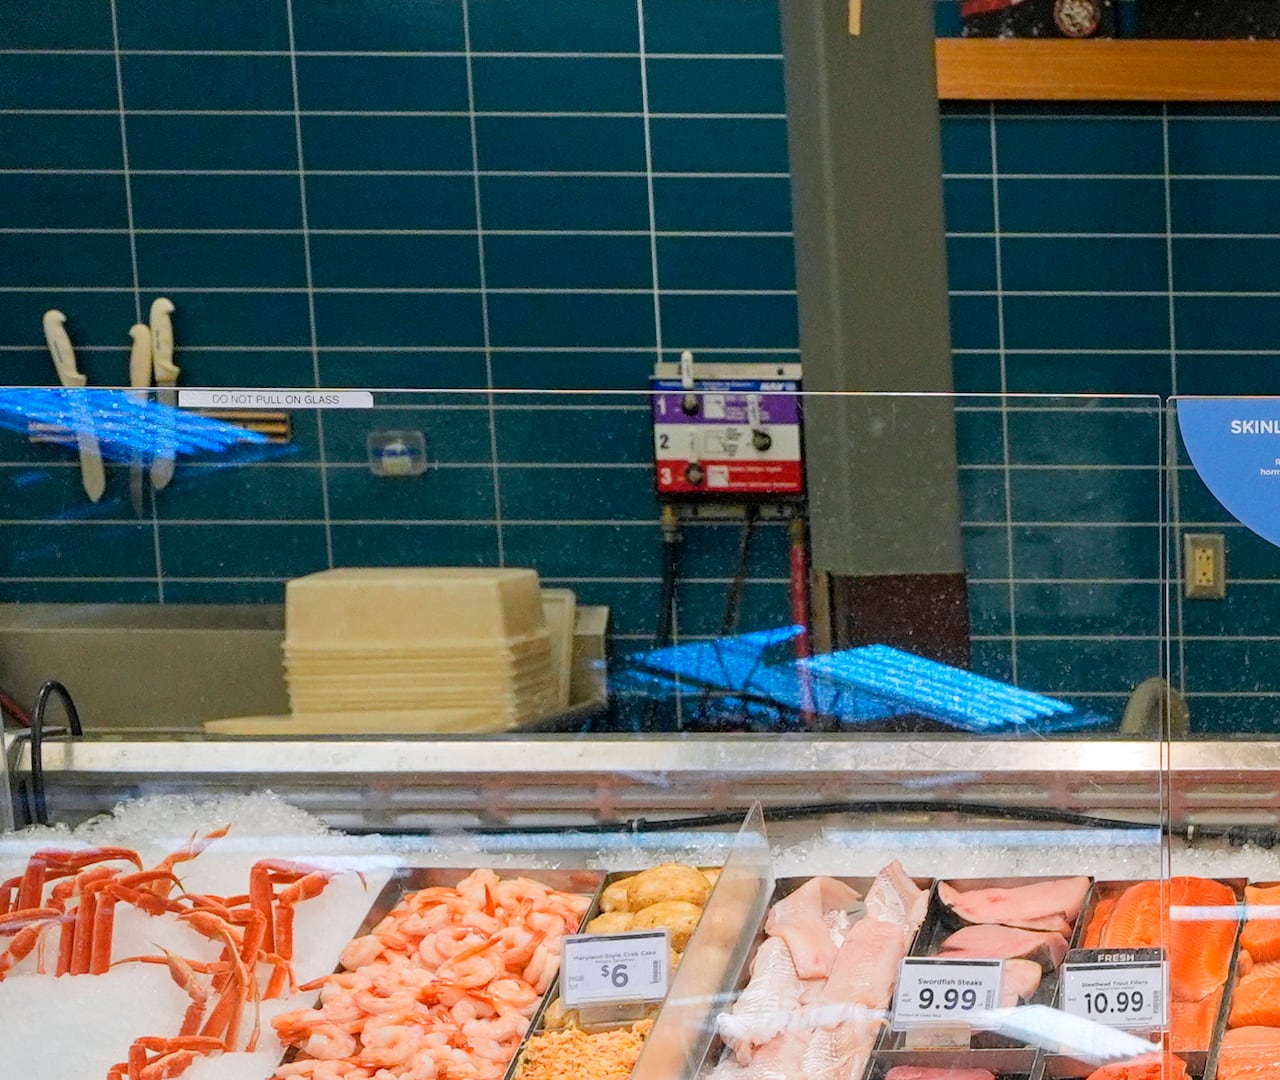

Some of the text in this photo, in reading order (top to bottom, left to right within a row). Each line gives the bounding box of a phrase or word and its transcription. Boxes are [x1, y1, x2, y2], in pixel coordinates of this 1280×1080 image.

[212, 394, 340, 405] DO NOT PULL ON GLASS
[658, 434, 670, 449] 2
[660, 467, 673, 485] 3
[1097, 953, 1135, 962] FRESH
[600, 964, 629, 988] $6
[918, 988, 977, 1011] 9.99
[1084, 991, 1144, 1014] 10.99
